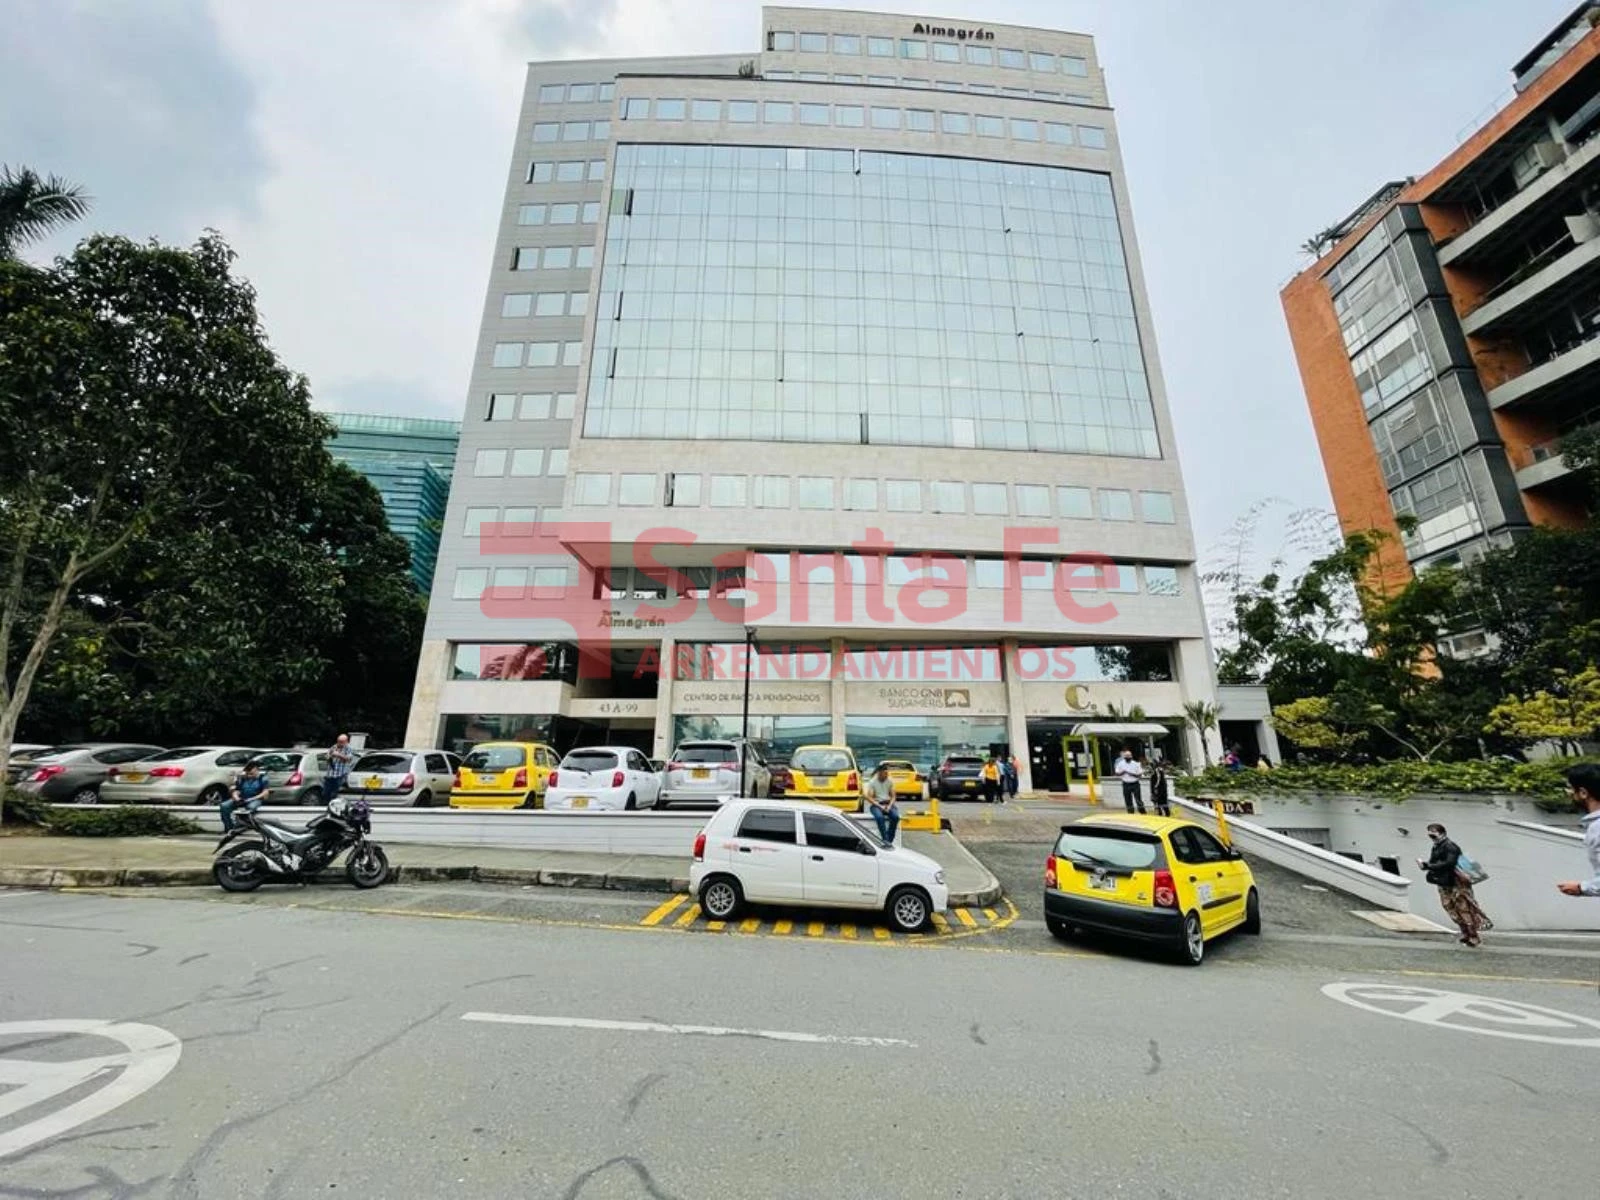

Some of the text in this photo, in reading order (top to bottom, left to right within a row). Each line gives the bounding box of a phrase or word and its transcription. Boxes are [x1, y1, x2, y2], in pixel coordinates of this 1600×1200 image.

[912, 22, 995, 40] Almagrán
[597, 615, 665, 629] Almagrán
[683, 693, 717, 702] CENTRO
[879, 688, 943, 698] BANCO GNB
